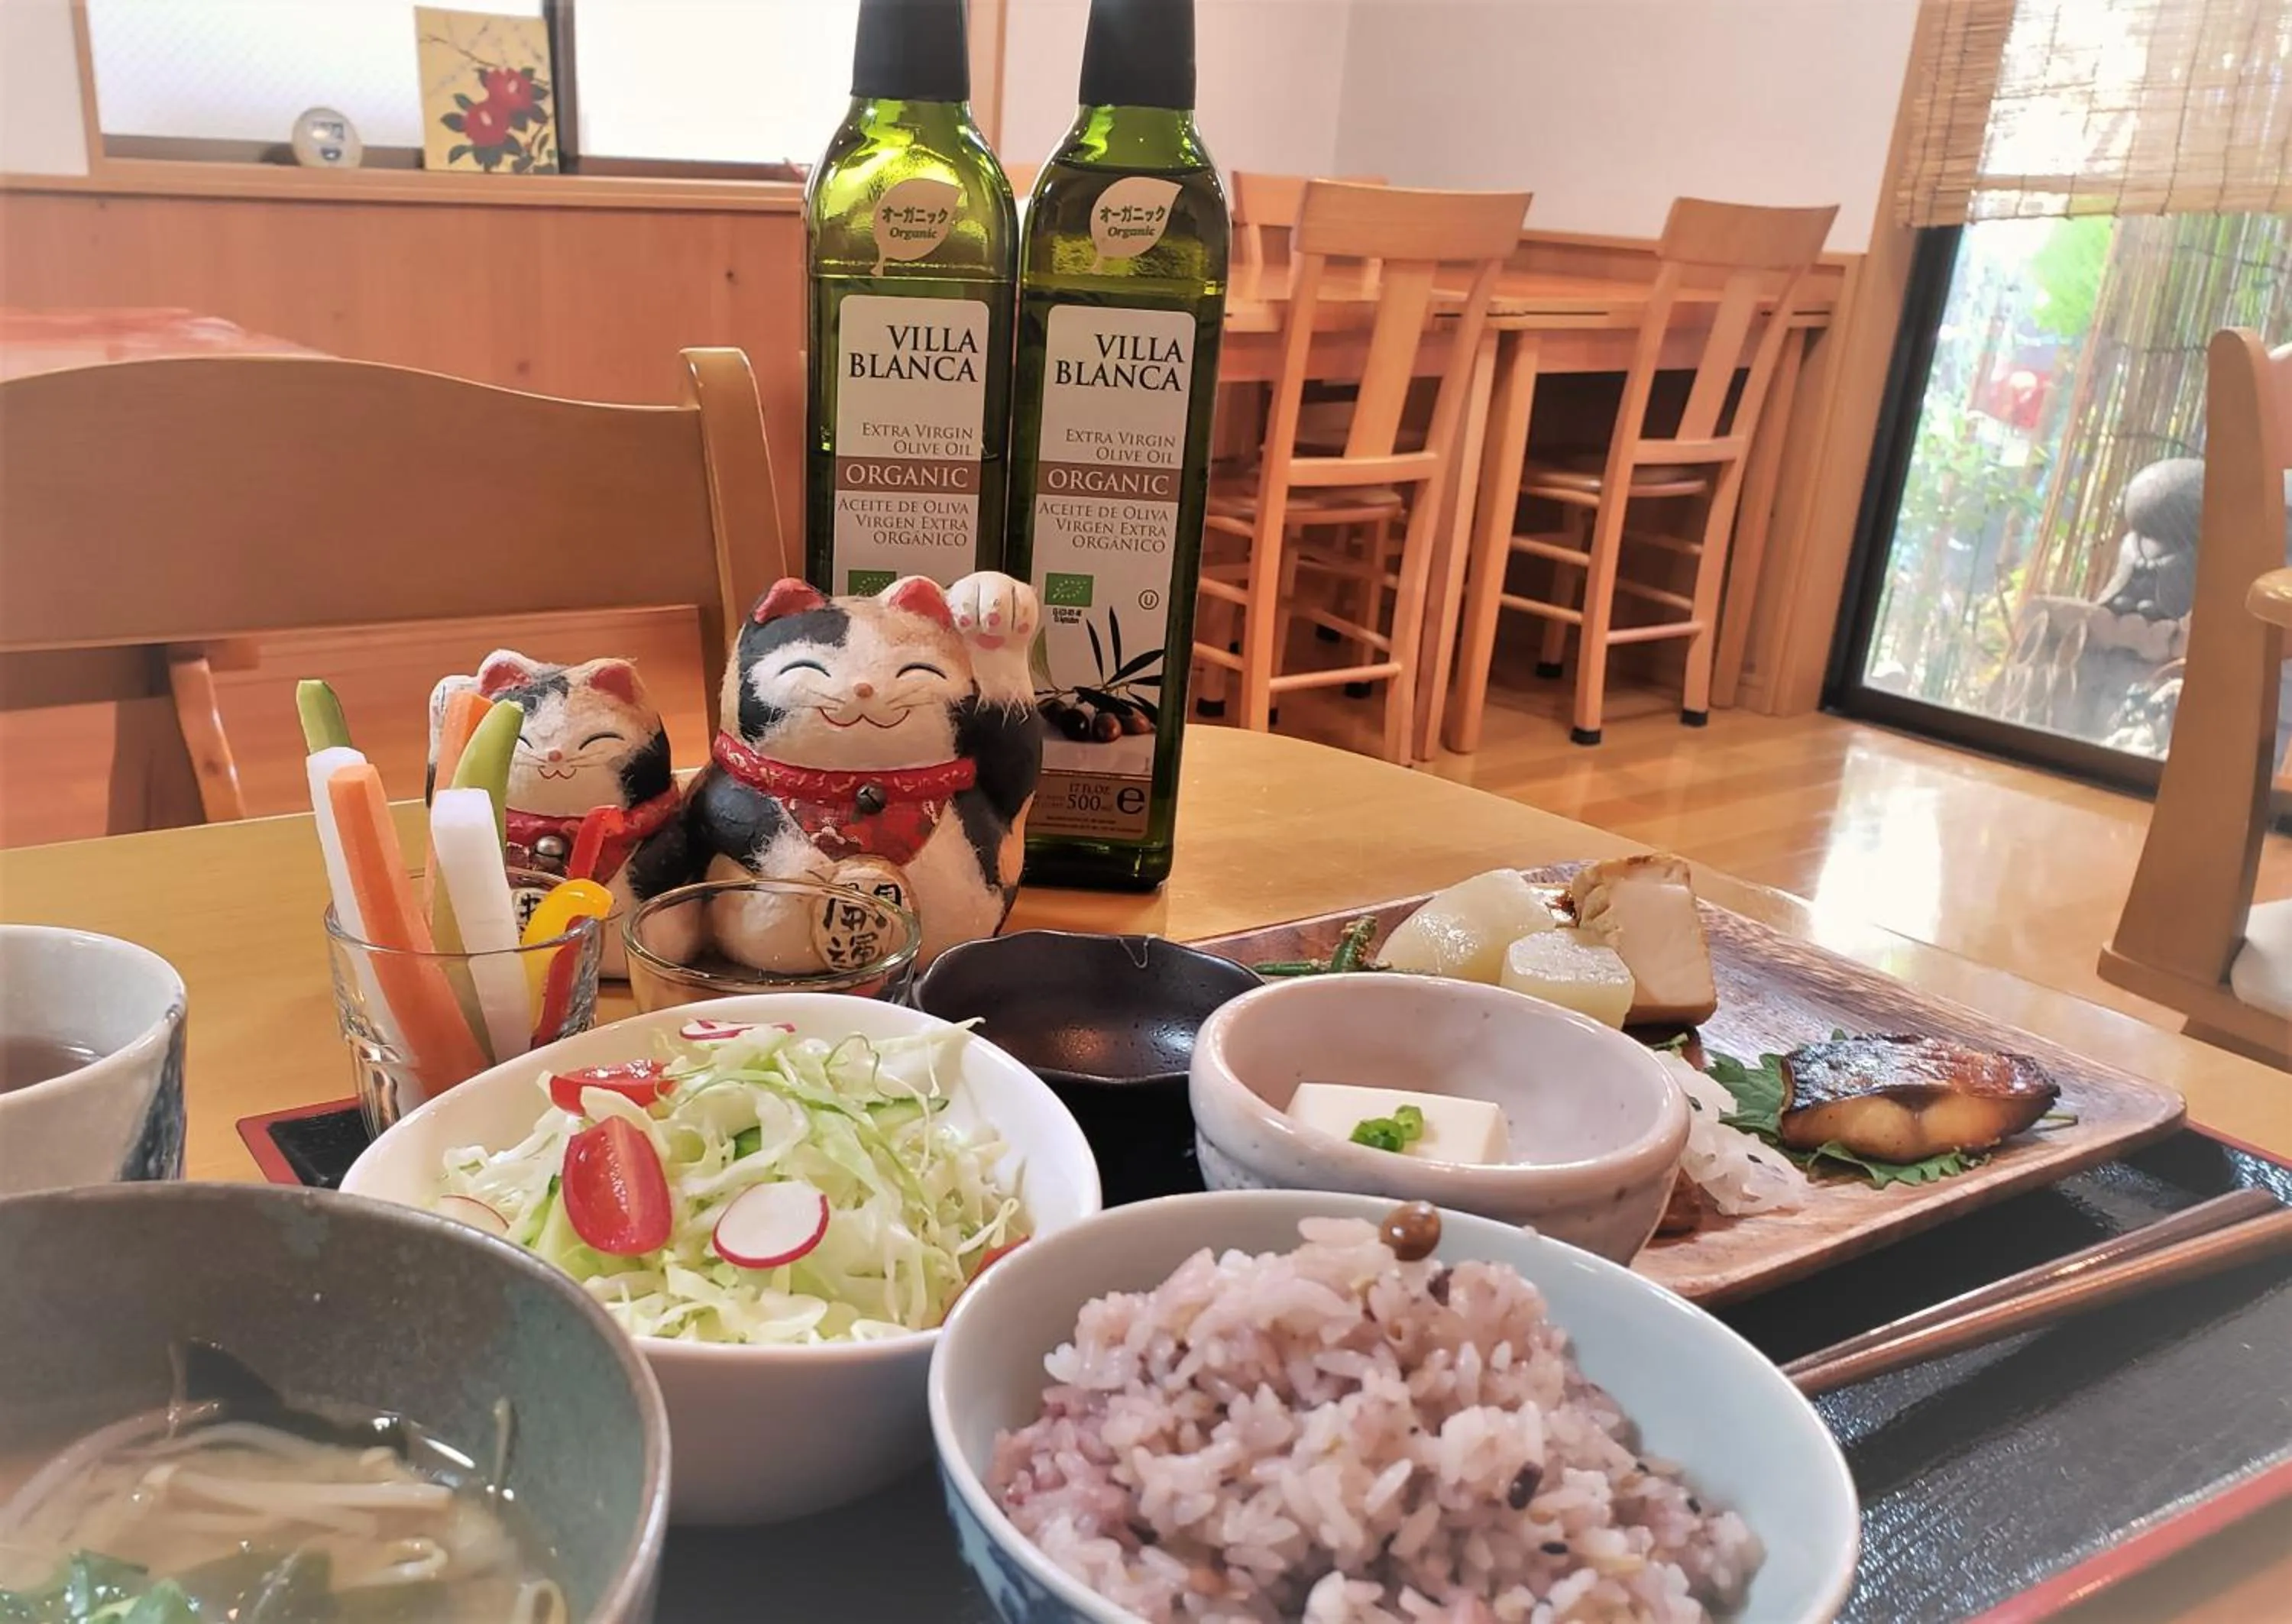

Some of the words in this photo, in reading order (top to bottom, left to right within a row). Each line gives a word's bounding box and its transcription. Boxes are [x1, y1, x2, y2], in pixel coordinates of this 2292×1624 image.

[882, 205, 949, 224] オーガニック
[1100, 205, 1166, 224] オーガニック
[889, 226, 937, 241] Organic
[1107, 225, 1156, 239] Organic
[886, 325, 979, 354] VILLA
[1094, 334, 1185, 363] VILLA
[848, 352, 979, 383] BLANCA
[1055, 360, 1182, 392] BLANCA
[862, 422, 911, 438] EXTRA
[915, 424, 973, 440] VIRGIN
[1065, 429, 1113, 444] EXTRA
[1118, 432, 1177, 448] VIRGIN
[892, 439, 940, 455] OLIVE
[944, 442, 974, 456] OIL
[1096, 446, 1143, 463] OLIVE
[845, 463, 970, 488] ORGANIC
[1047, 467, 1170, 496] ORGANIC
[837, 498, 892, 513] ACEITE
[898, 500, 921, 513] DE
[923, 500, 970, 515] OLIVA
[1038, 502, 1094, 517] ACEITE
[1098, 506, 1118, 519] DE
[1122, 506, 1169, 522] OLIVA
[855, 513, 915, 529] VIRGEN
[921, 516, 970, 531] EXTRA
[1055, 518, 1115, 534] VIRGEN
[1121, 522, 1167, 538] EXTRA
[1066, 794, 1101, 811] 500
